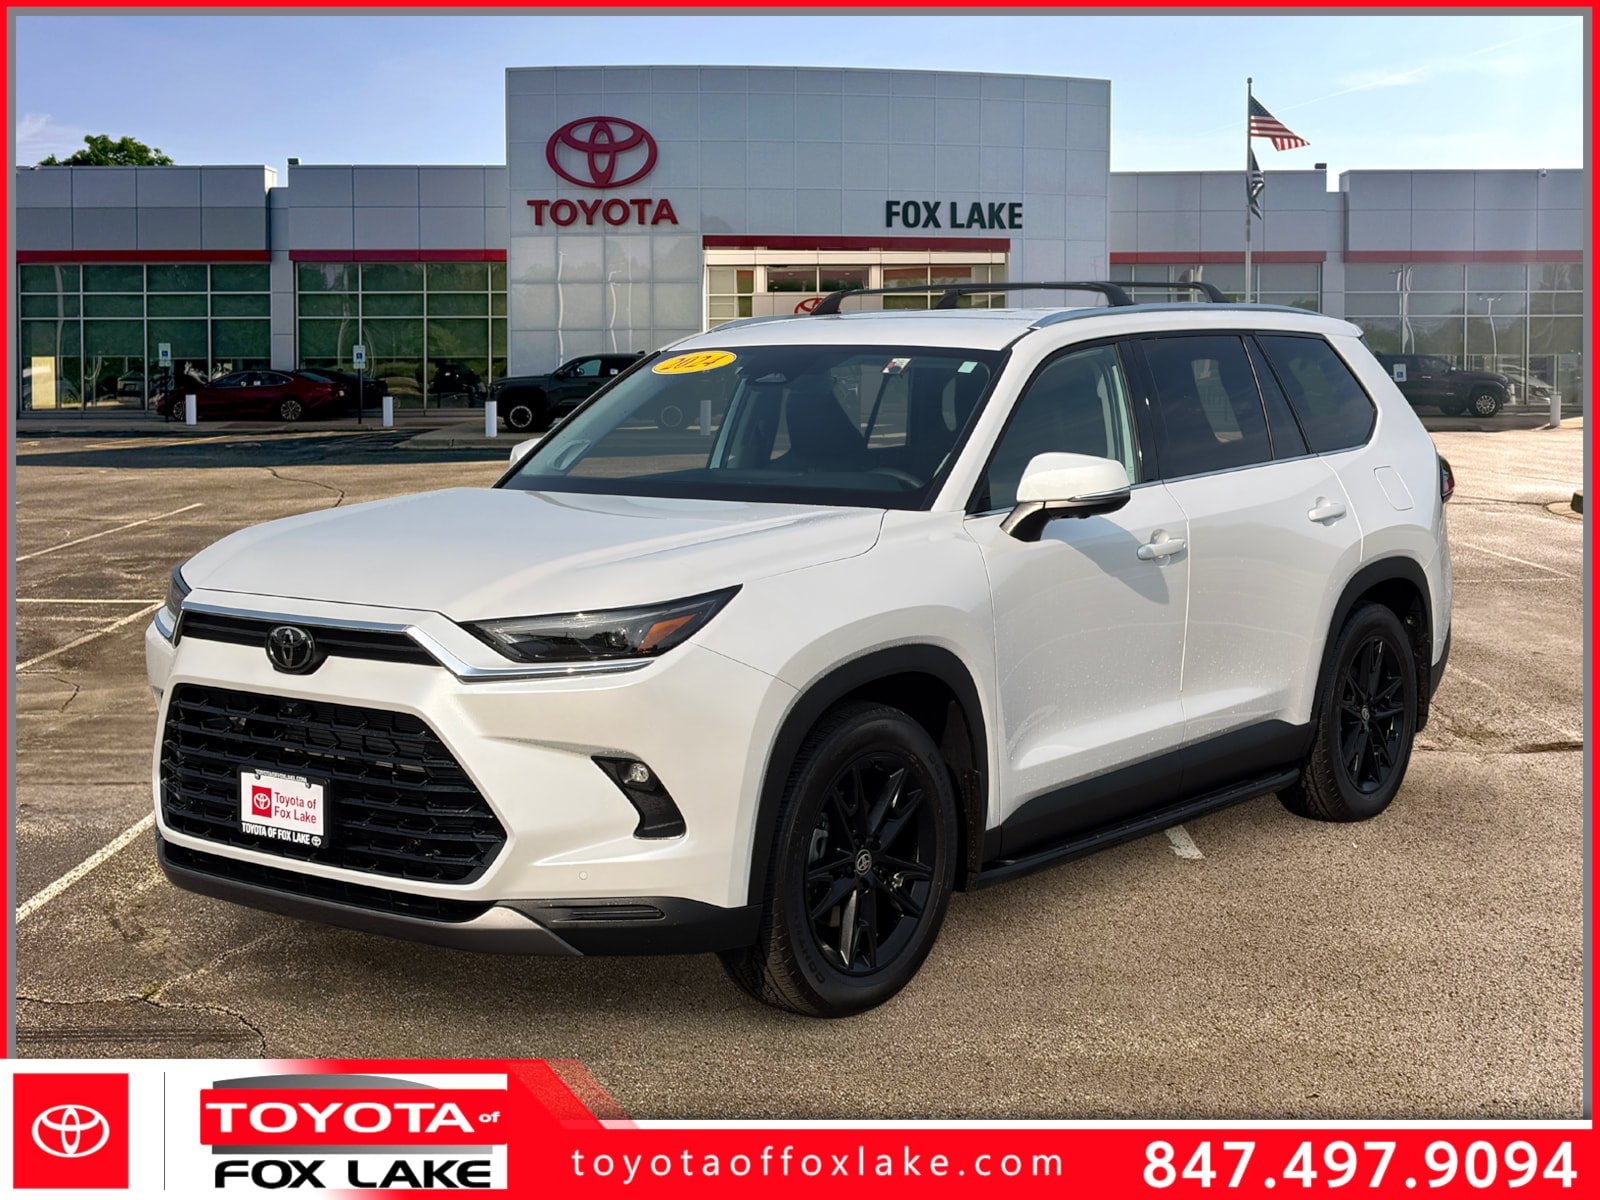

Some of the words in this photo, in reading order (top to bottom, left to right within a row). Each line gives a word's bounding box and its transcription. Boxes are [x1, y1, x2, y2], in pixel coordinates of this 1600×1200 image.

[527, 199, 678, 226] TOYOTA
[885, 200, 942, 229] FOX
[950, 201, 1023, 230] LAKE
[659, 355, 729, 370] 2024
[274, 792, 304, 808] Toyota
[307, 799, 316, 810] of
[274, 806, 291, 819] Fox
[294, 809, 317, 824] Lake
[241, 822, 267, 838] TOYOTA
[267, 827, 277, 838] OF
[277, 829, 292, 841] FOX
[292, 832, 311, 845] LAKE
